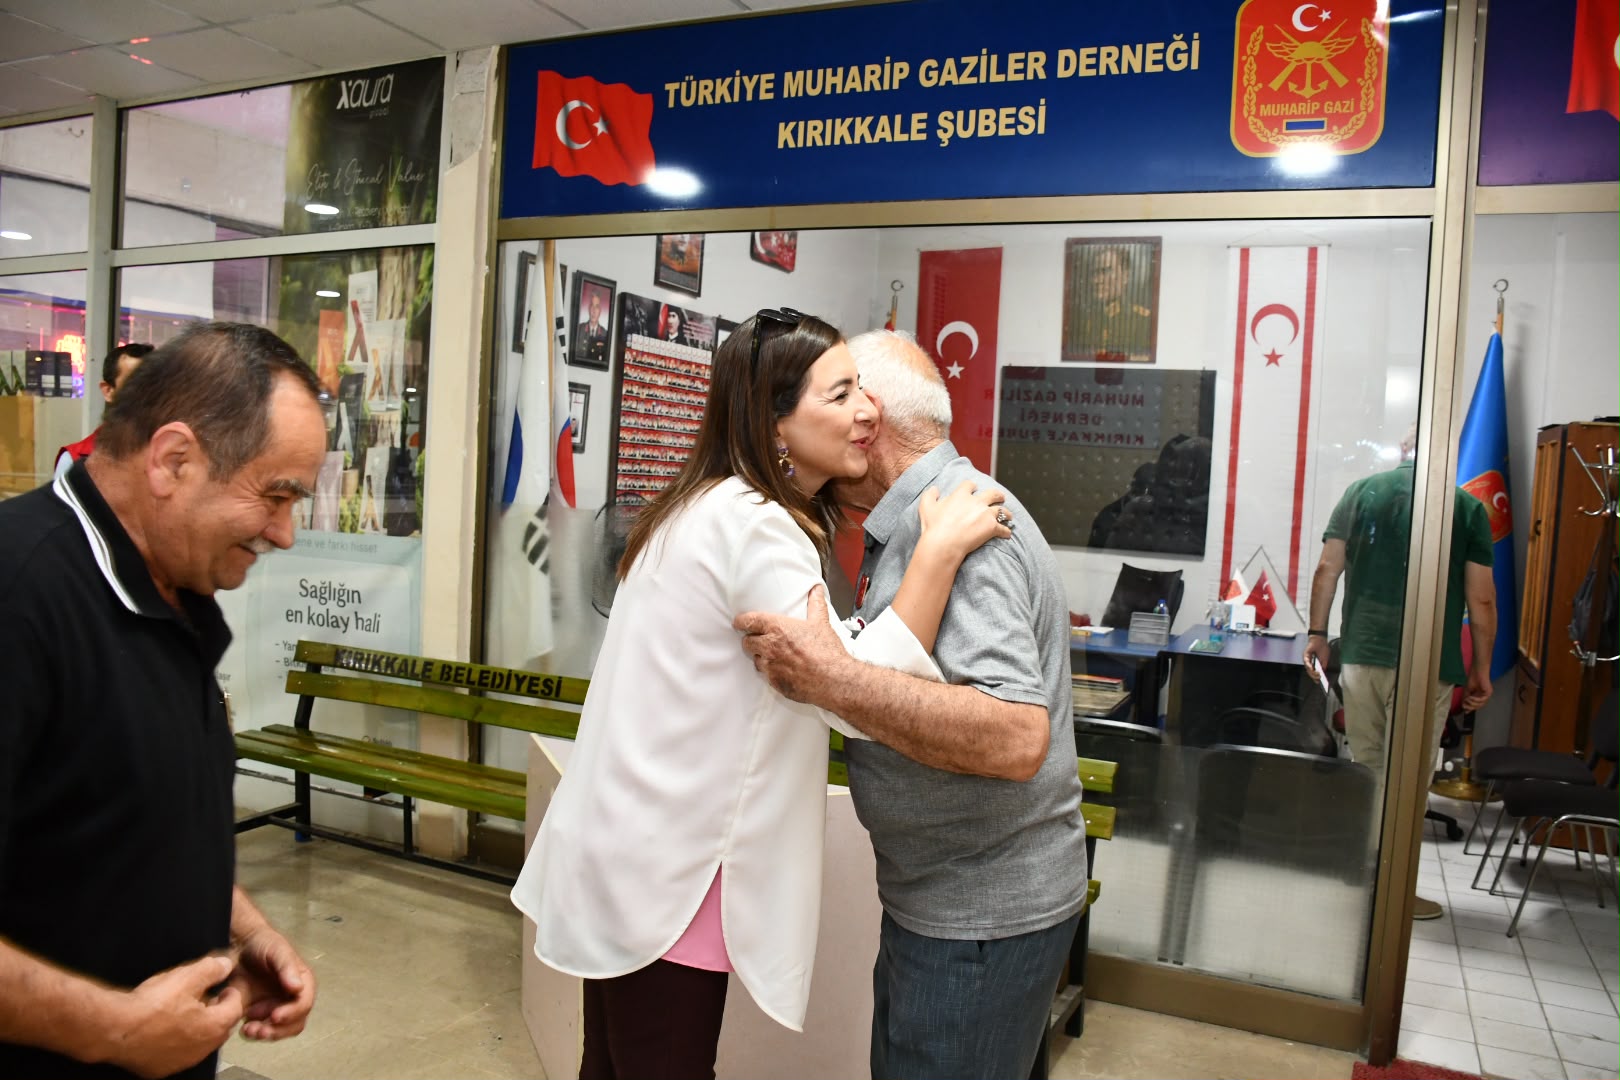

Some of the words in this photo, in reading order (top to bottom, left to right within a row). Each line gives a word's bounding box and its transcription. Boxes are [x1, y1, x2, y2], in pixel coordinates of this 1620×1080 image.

[664, 69, 776, 109] TÜRKİYE
[783, 55, 910, 99] MUHARİP
[918, 47, 1047, 88] GAZİLER
[1056, 32, 1200, 78] DERNEĞİ
[777, 112, 929, 149] KIRIKKALE
[936, 98, 1046, 147] ŞUBESİ
[1259, 99, 1320, 117] MUHARİP
[1323, 97, 1355, 114] GAZİ
[299, 578, 362, 608] Sağlığın
[285, 608, 303, 624] en
[307, 605, 350, 634] kolay
[354, 610, 381, 634] hali
[335, 649, 435, 680] KIRIKKALE
[439, 665, 563, 699] BELEDİYESİ
